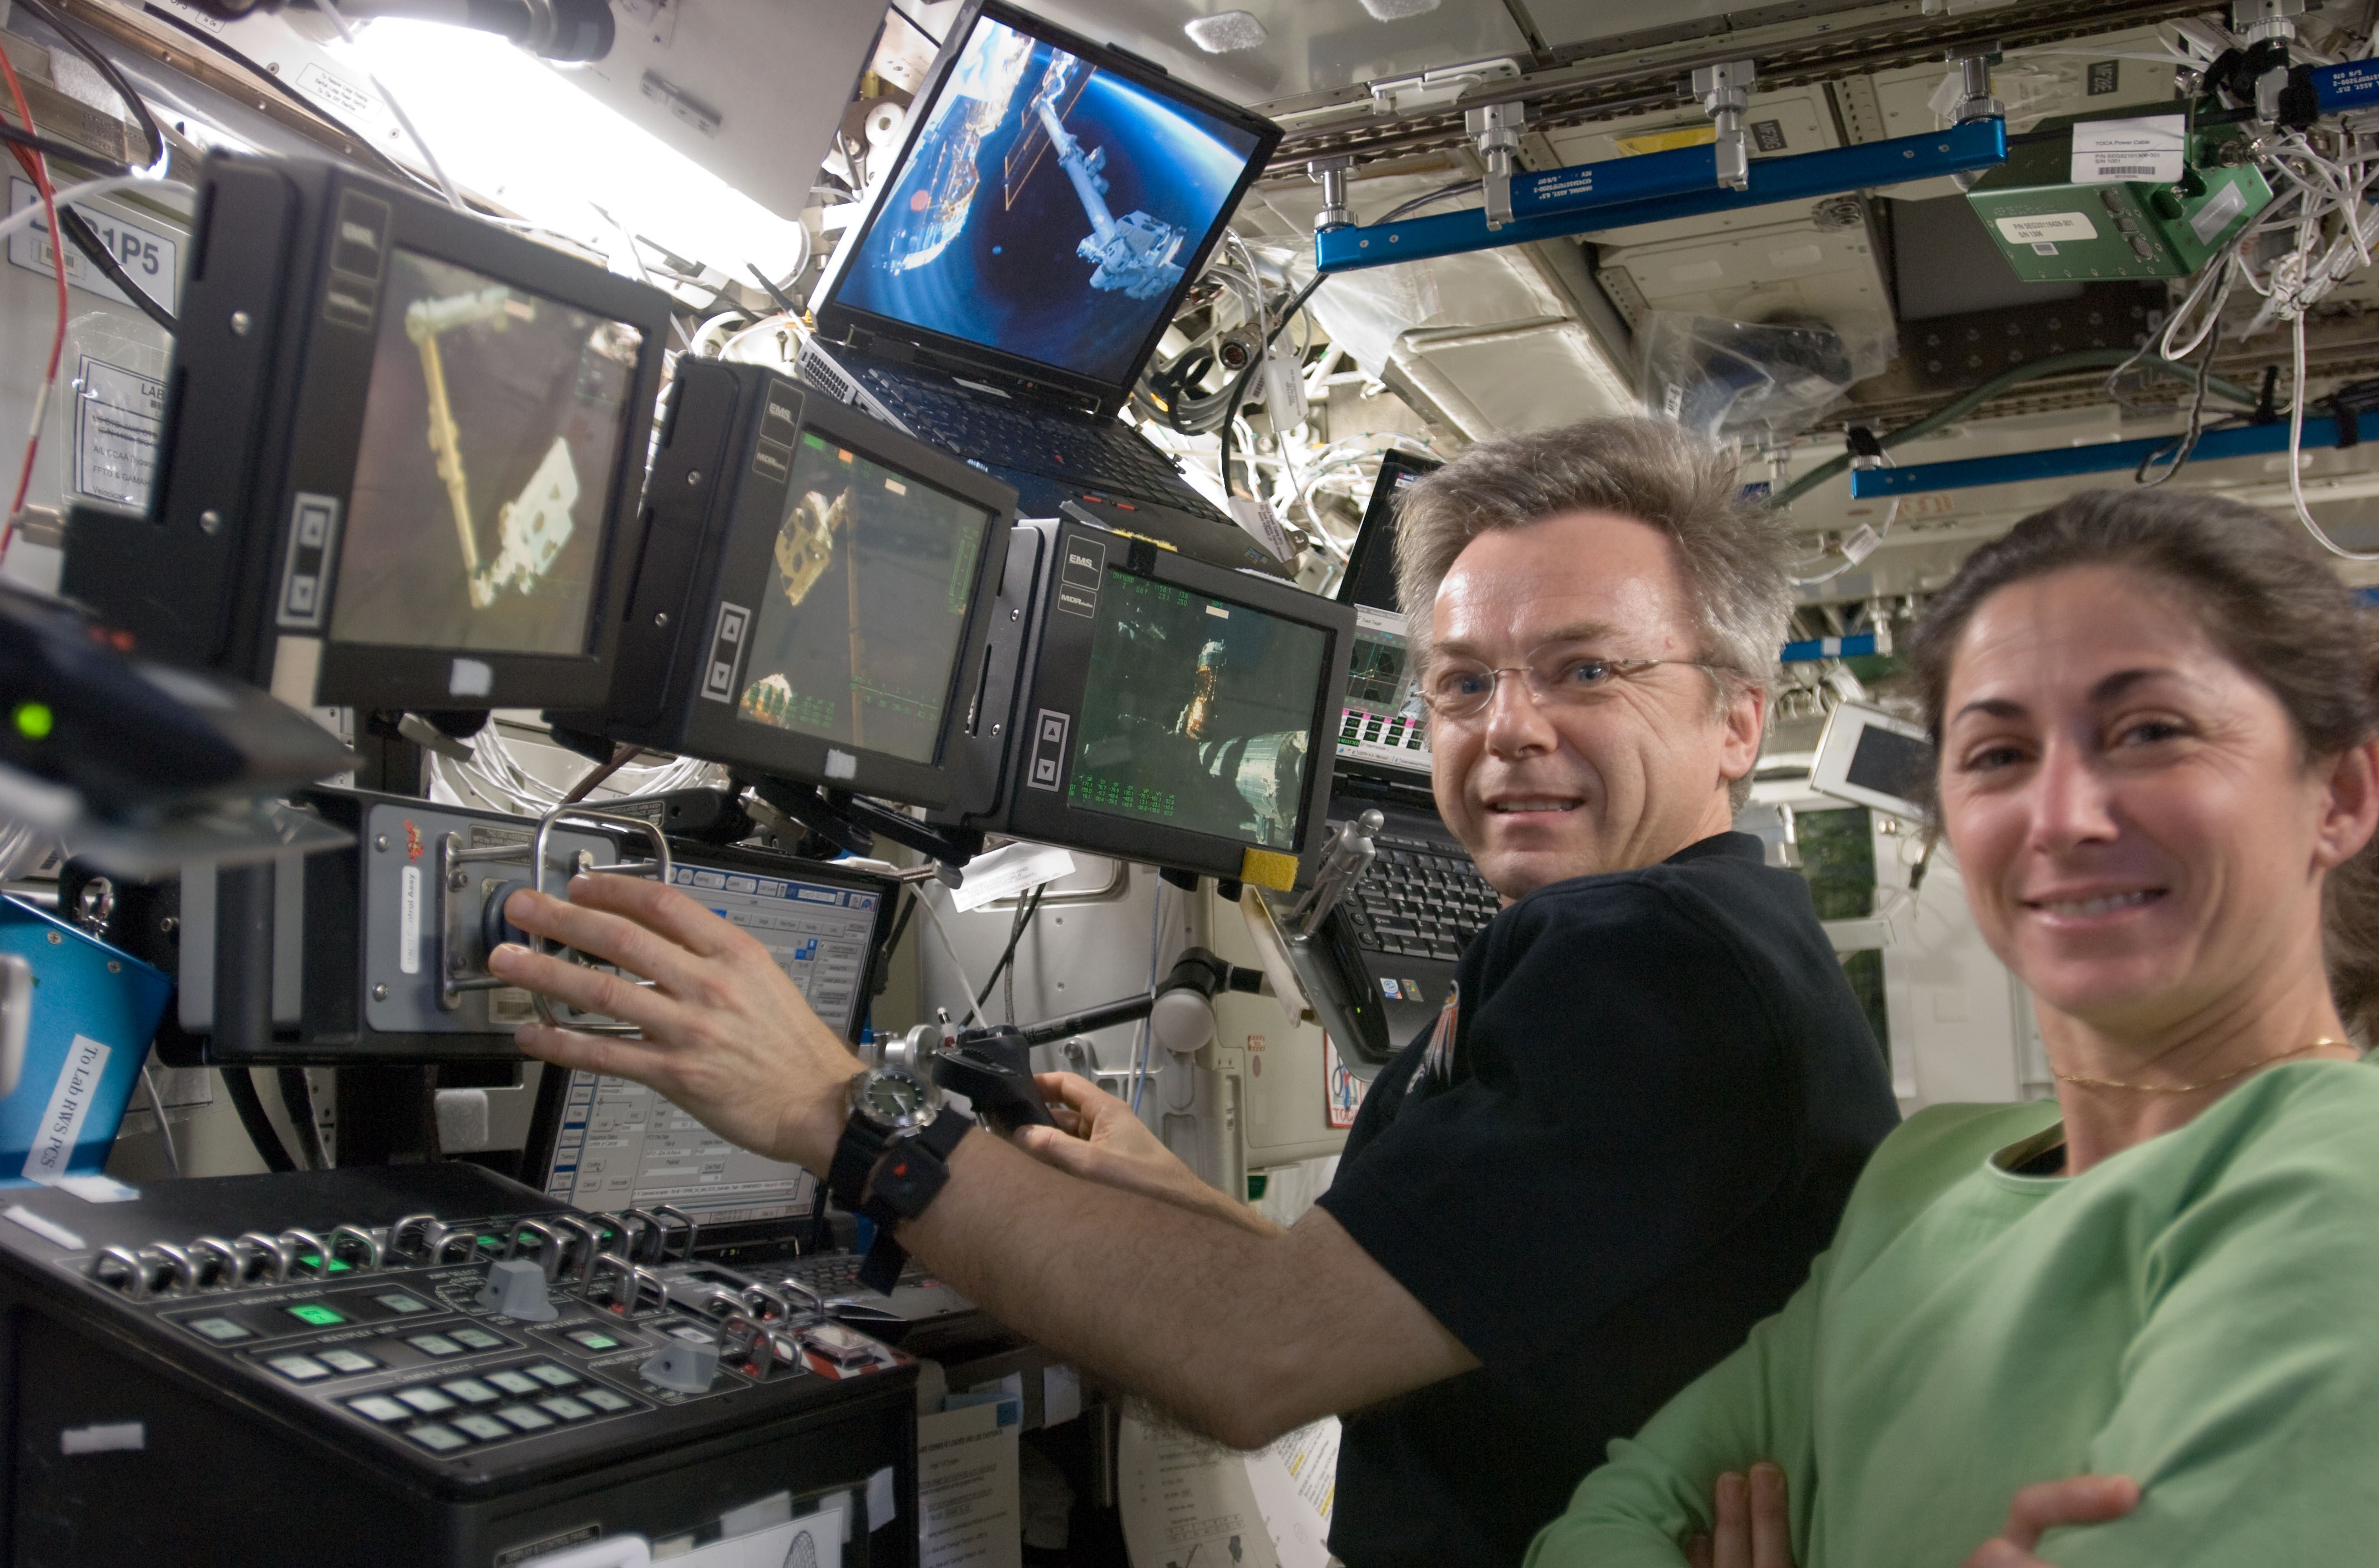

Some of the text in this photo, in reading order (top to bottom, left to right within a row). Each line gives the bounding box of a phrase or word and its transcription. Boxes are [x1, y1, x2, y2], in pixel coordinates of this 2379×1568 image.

[769, 402, 791, 419] EMS
[1069, 554, 1092, 567] EMS
[407, 873, 416, 898] Assy
[40, 1046, 98, 1169] To Lab RWS PCS
